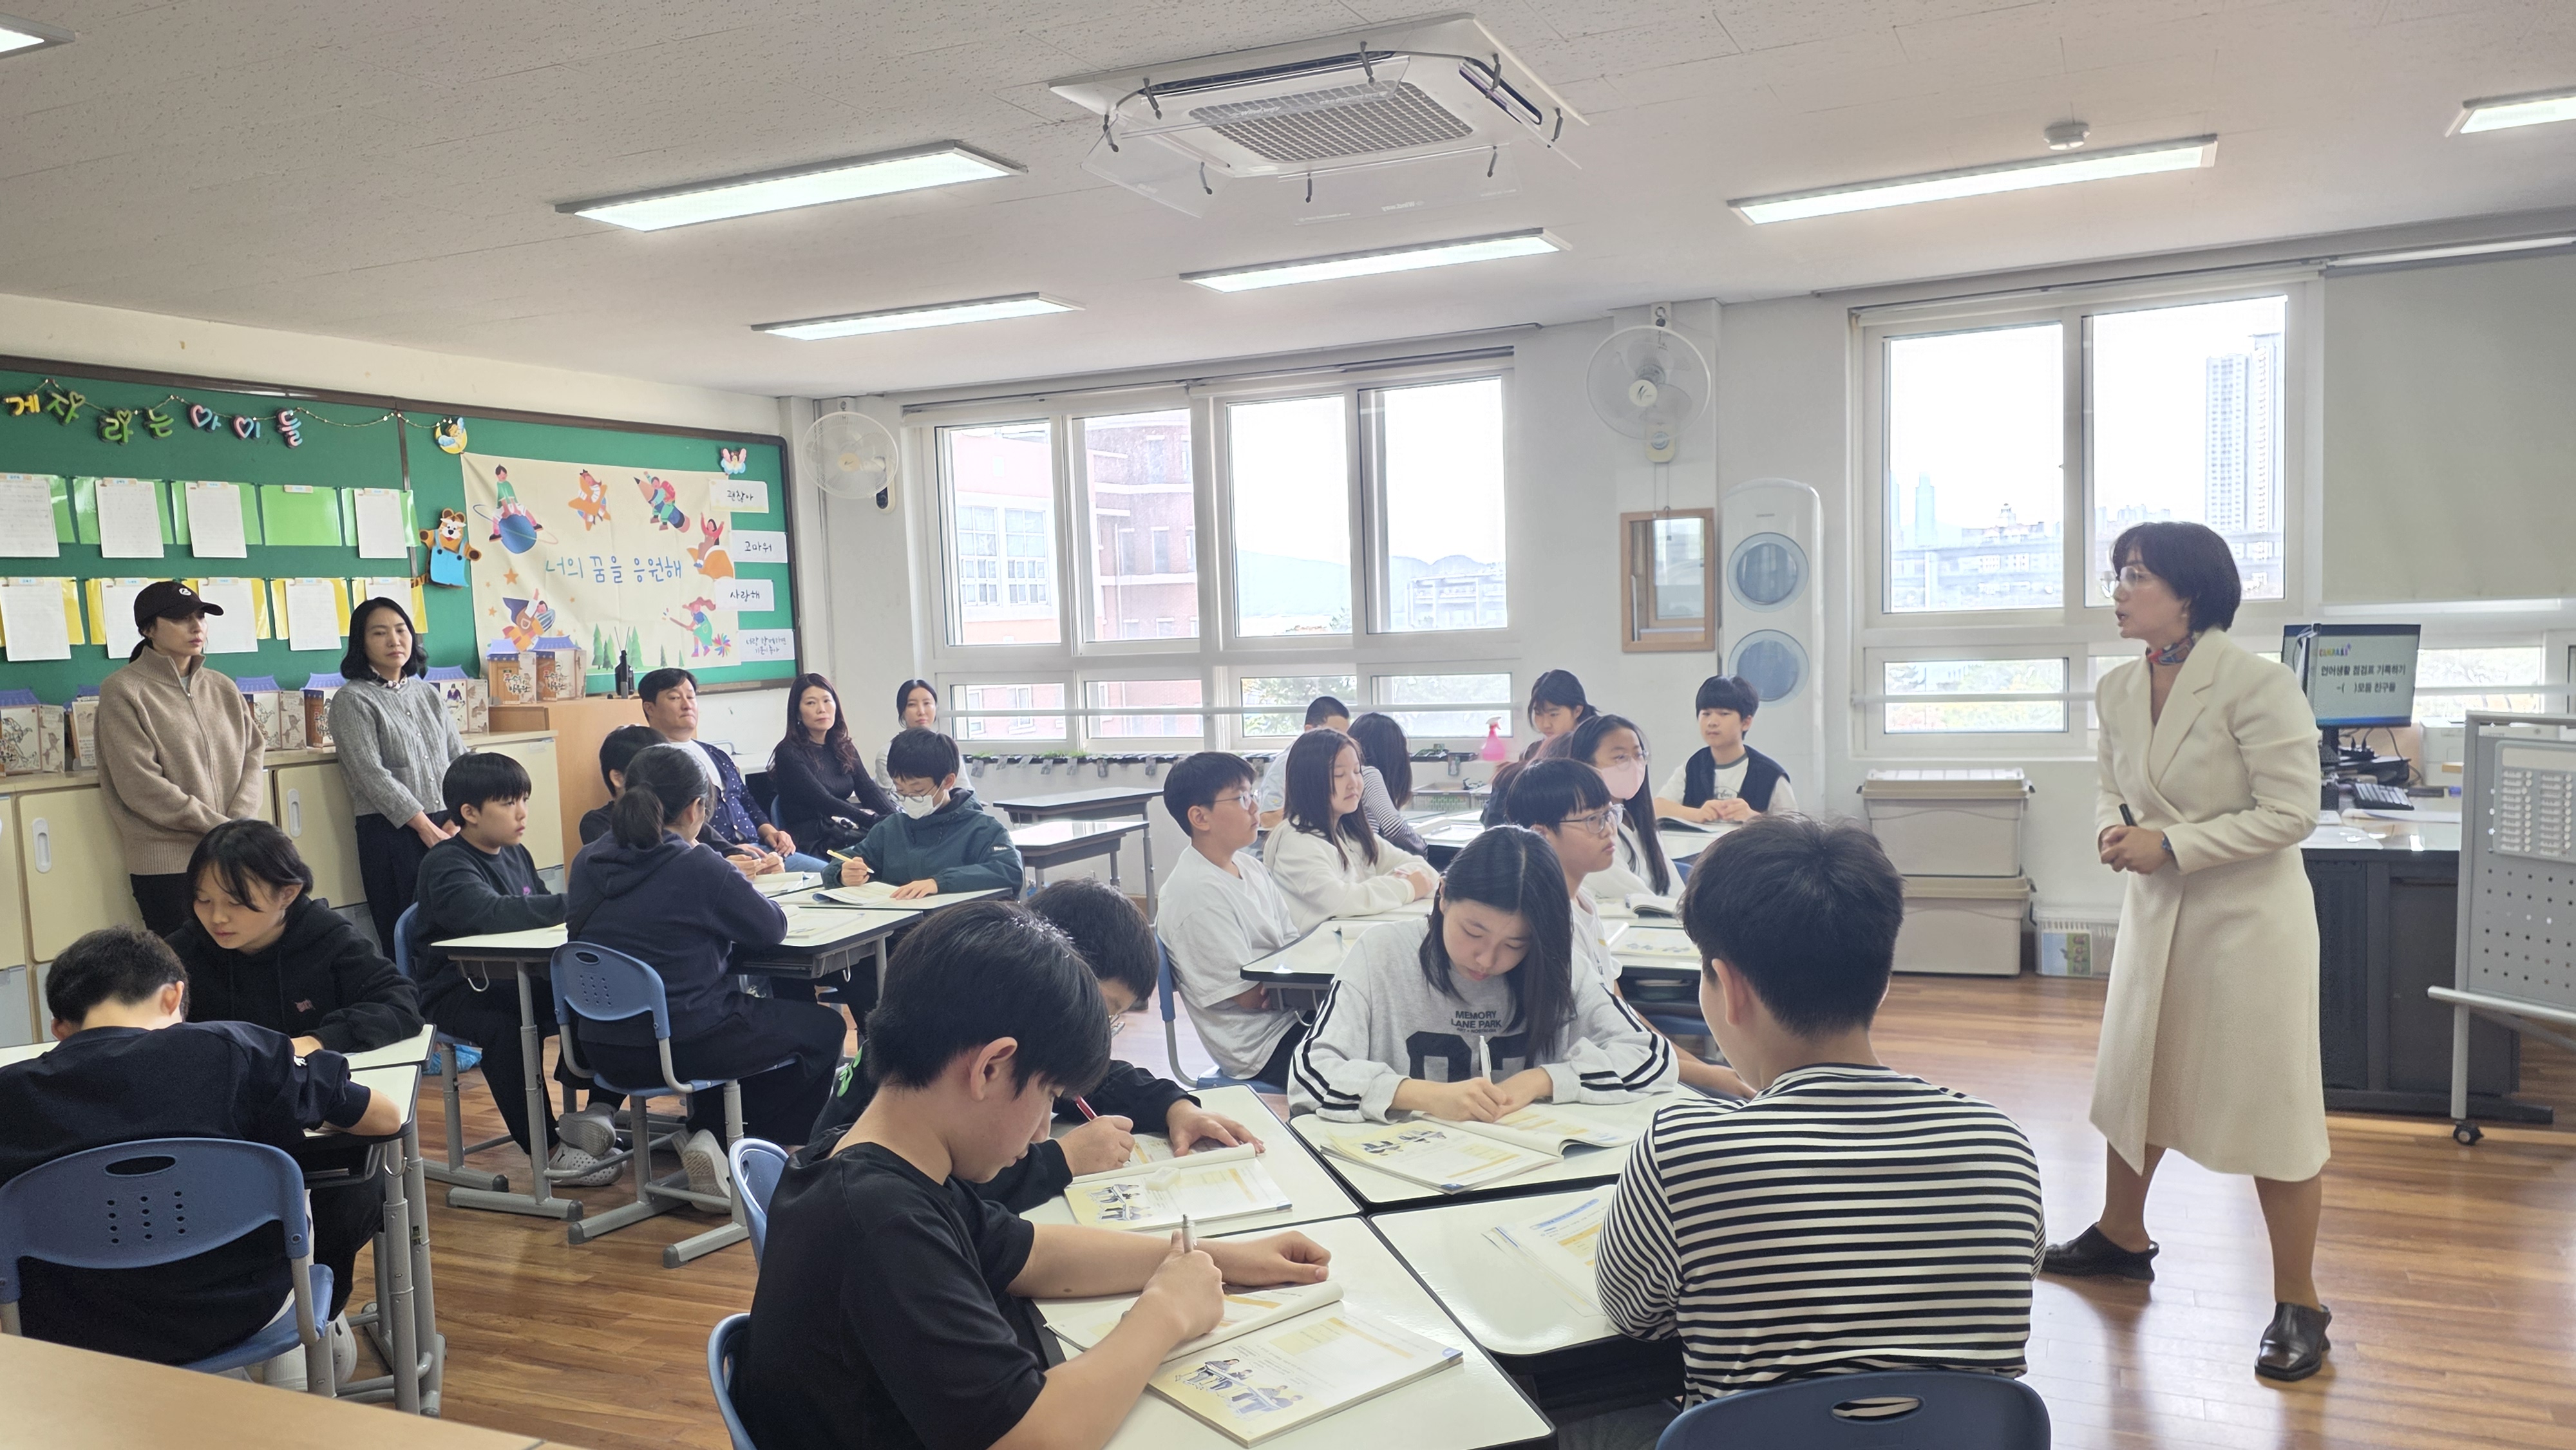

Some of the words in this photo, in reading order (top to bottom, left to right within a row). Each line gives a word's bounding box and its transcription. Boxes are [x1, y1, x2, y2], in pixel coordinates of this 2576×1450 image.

[726, 489, 754, 503] 괜찮아
[744, 540, 772, 552] 고마워
[545, 556, 583, 579] 너의
[589, 555, 623, 583] 꿈을
[633, 556, 681, 583] 응원해
[730, 588, 761, 602] 사랑해
[2320, 664, 2351, 677] 언어생활
[2376, 663, 2406, 676] 기록하기
[2374, 681, 2396, 693] 친구들
[1455, 1010, 1497, 1019] MEMORY
[1451, 1018, 1476, 1028] LANE
[1478, 1020, 1502, 1028] PARK
